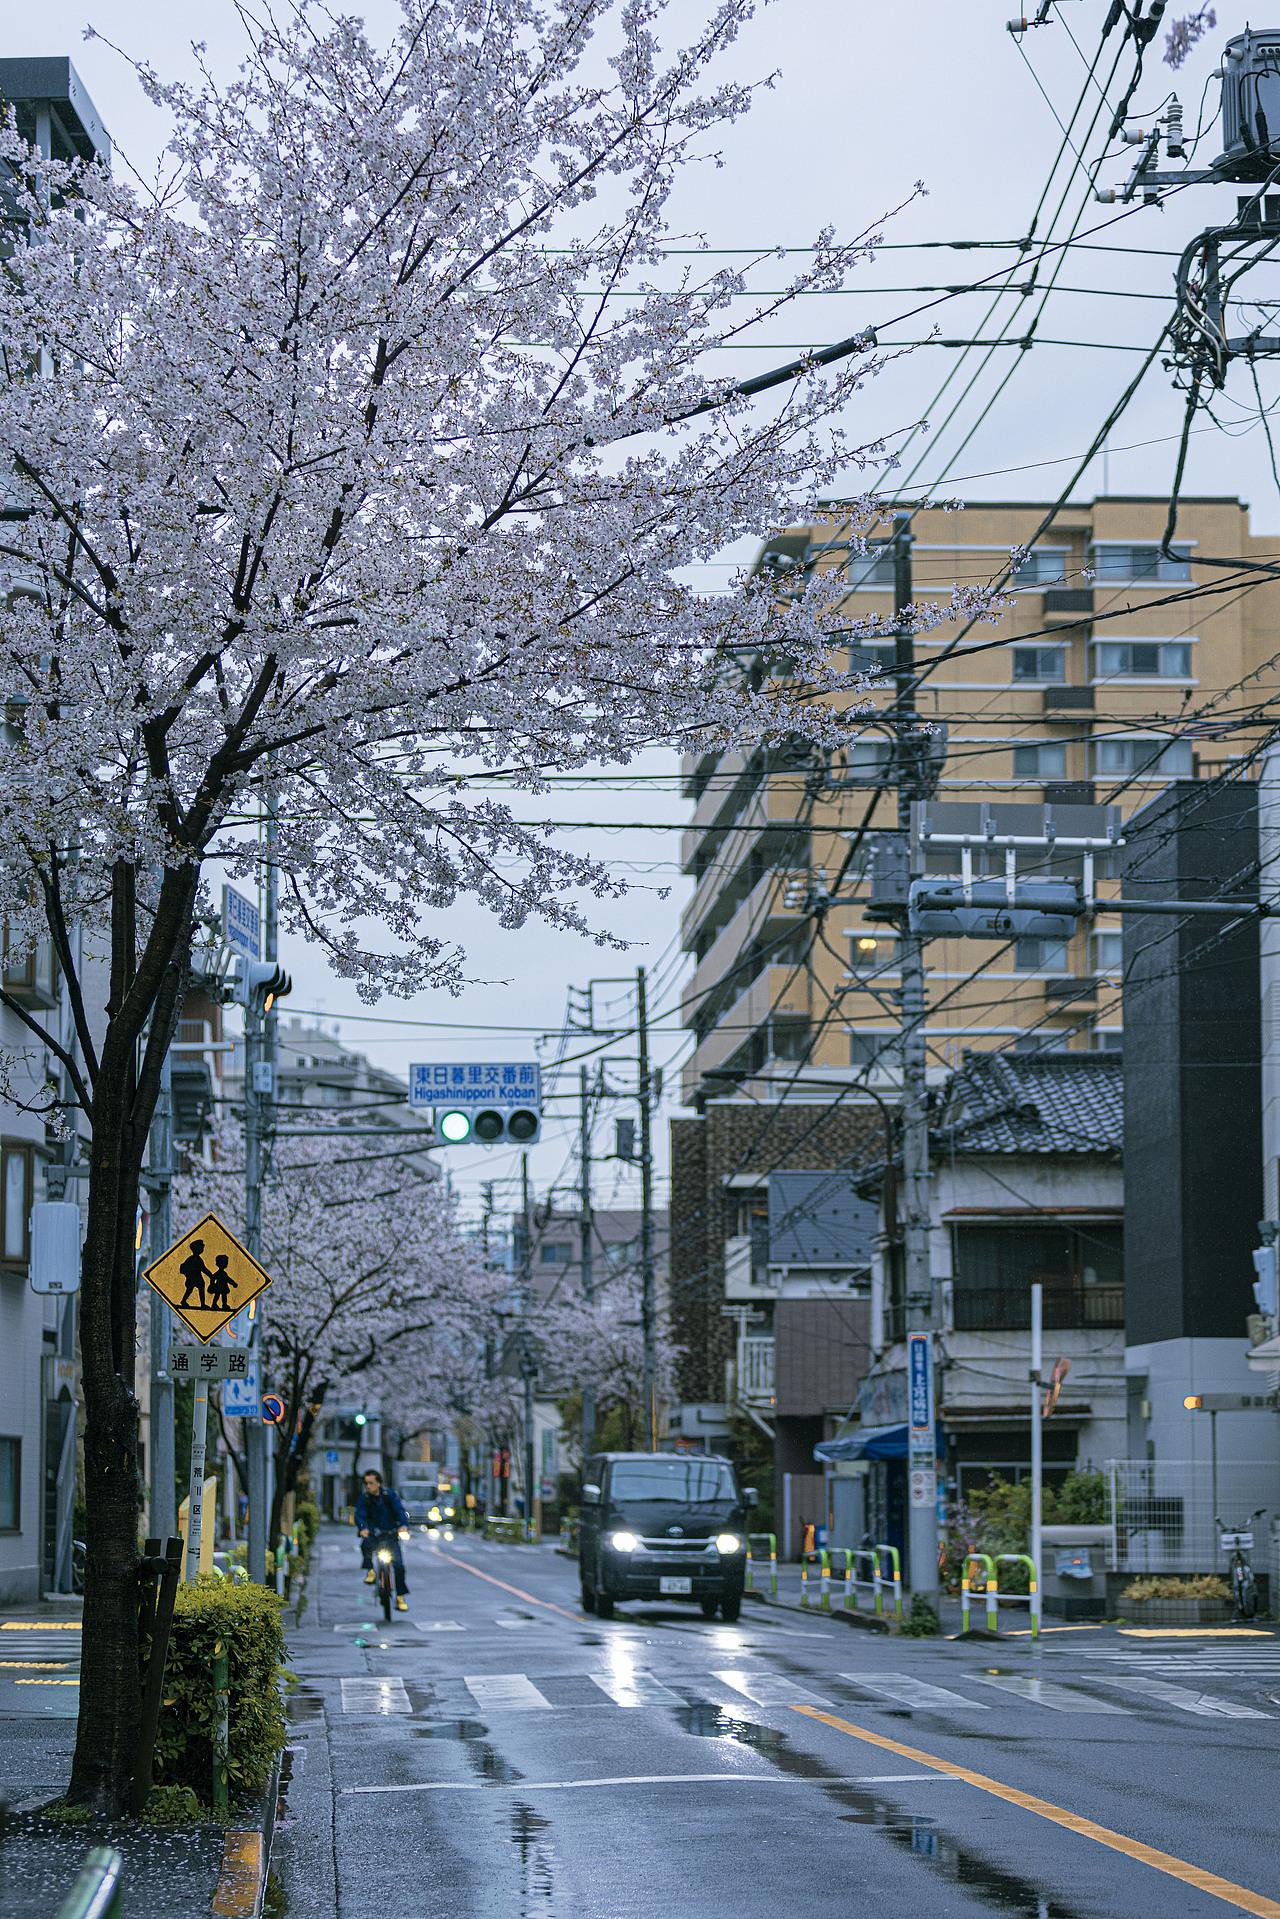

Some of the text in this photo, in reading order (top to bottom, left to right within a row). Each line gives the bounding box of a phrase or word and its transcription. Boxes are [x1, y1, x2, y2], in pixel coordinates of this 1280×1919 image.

[415, 1066, 534, 1085] 東日暮里交番前
[414, 1085, 536, 1102] Higashinippori Koban
[171, 1352, 247, 1373] 通学路
